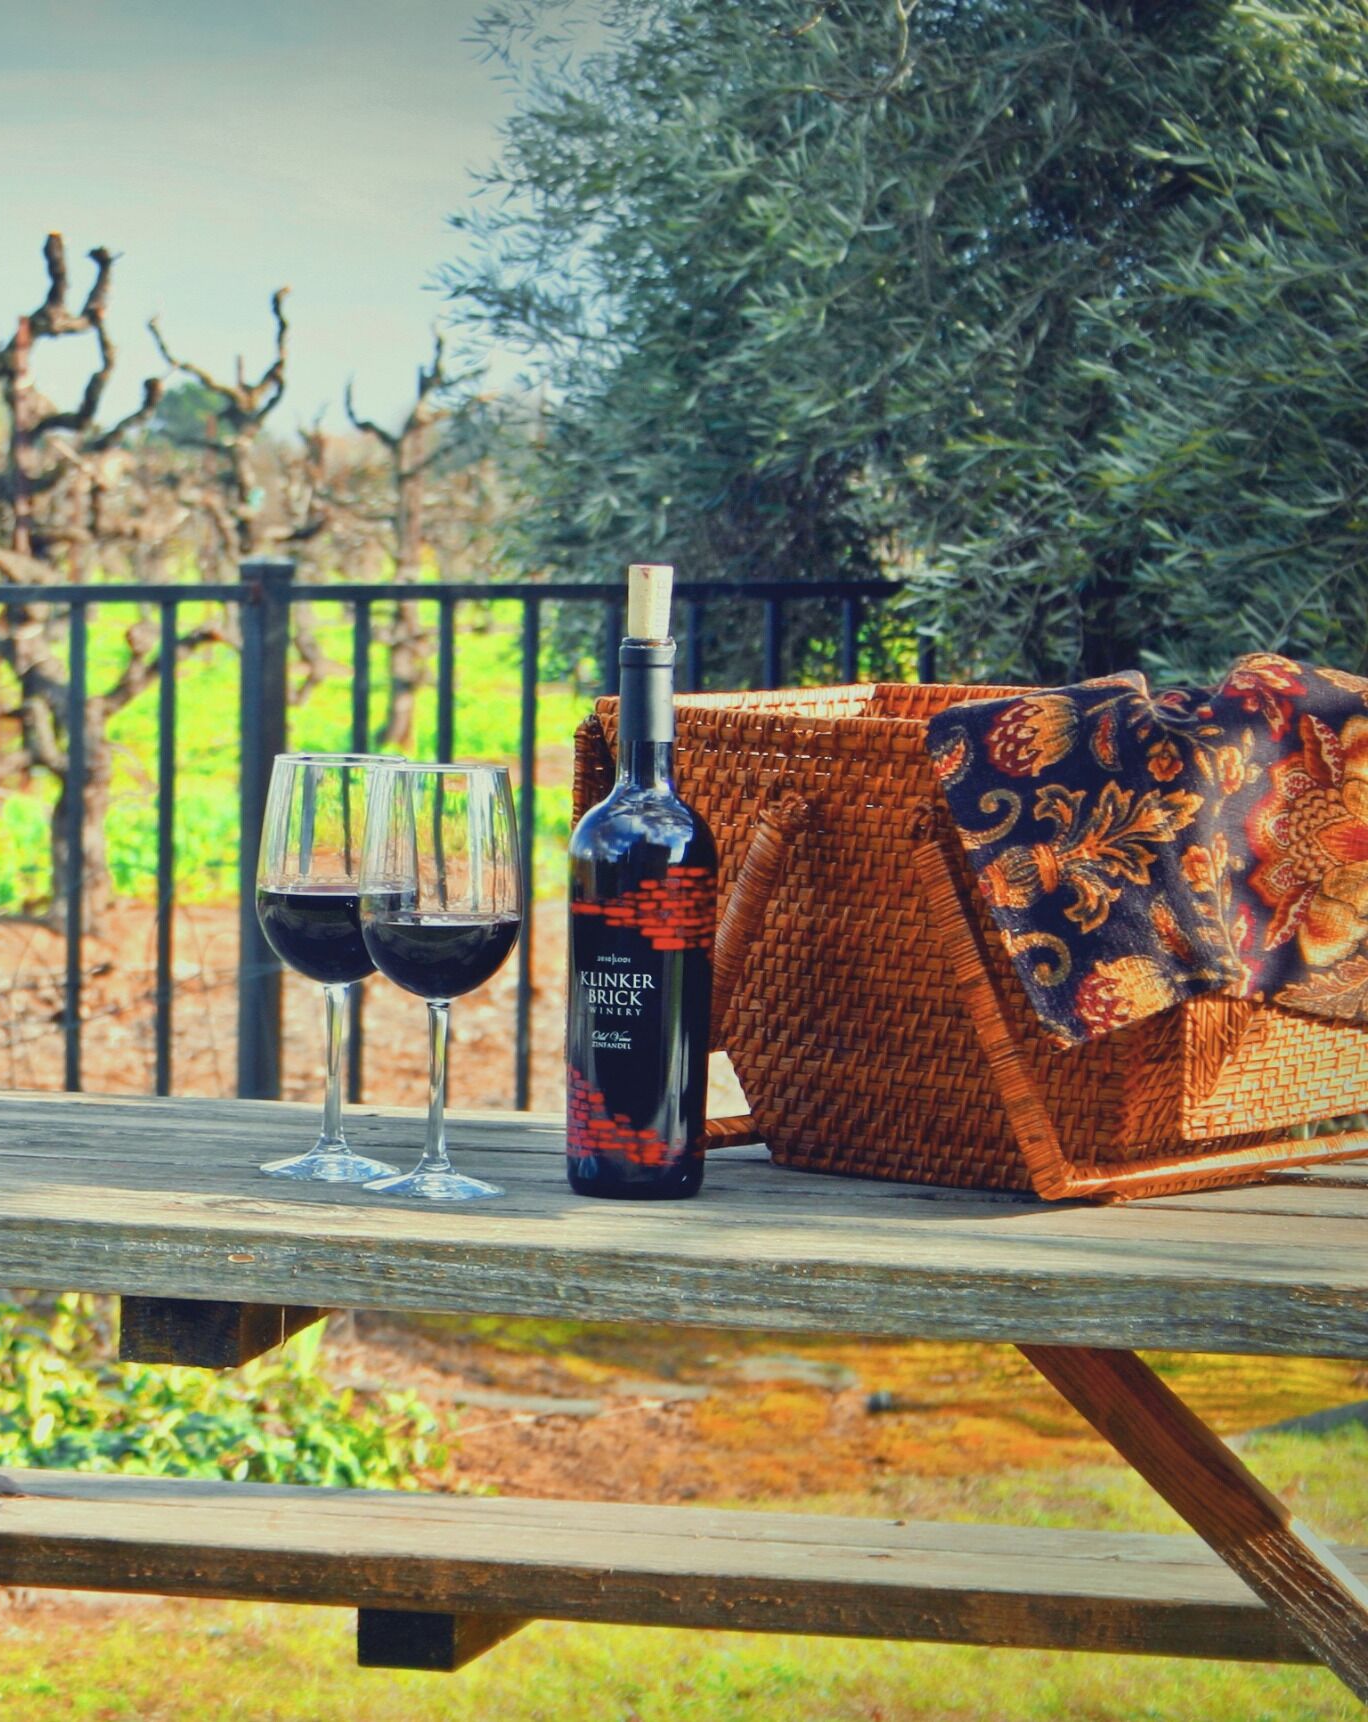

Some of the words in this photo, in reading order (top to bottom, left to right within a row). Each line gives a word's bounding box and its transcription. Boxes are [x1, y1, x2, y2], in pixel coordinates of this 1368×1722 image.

[580, 970, 655, 989] KLINKER
[588, 988, 643, 1006] BRICK
[589, 1006, 642, 1016] WINERY
[591, 1030, 609, 1041] Old
[591, 1041, 632, 1050] ZINFANDEL
